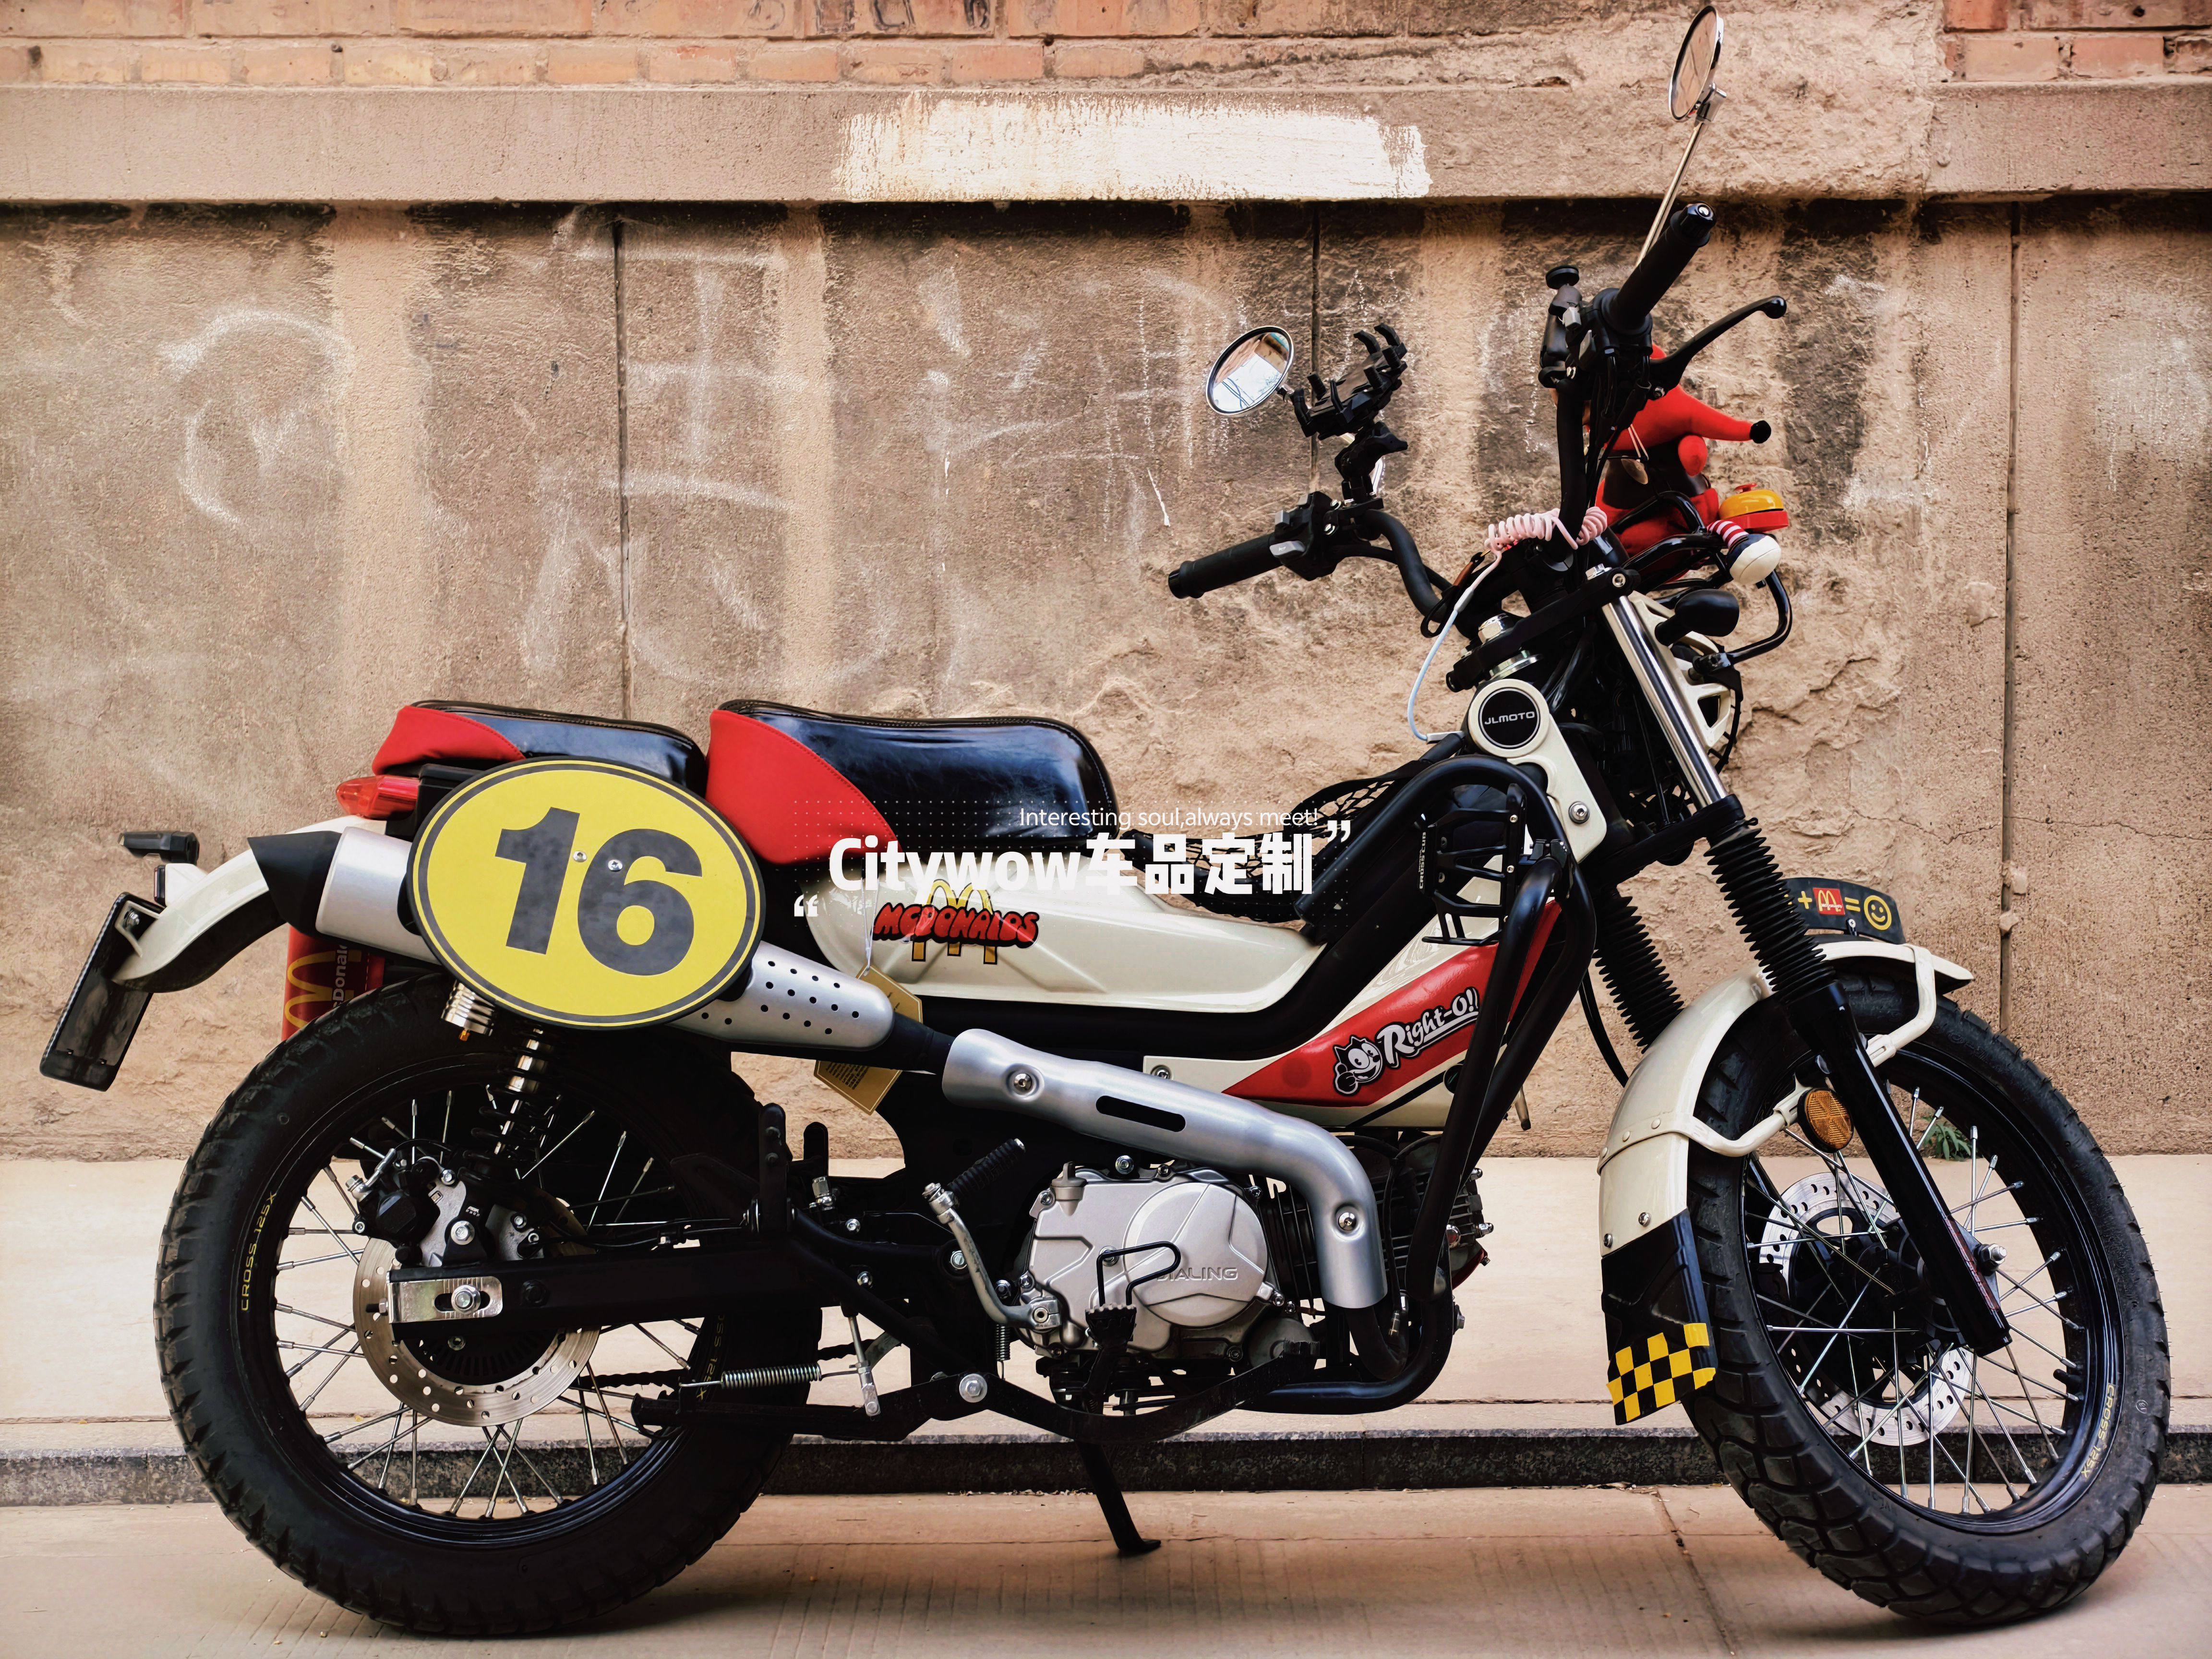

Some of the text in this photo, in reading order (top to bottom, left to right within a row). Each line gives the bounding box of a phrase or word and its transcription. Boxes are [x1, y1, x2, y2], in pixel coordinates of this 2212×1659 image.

[1484, 711, 1535, 725] JLMOTO
[494, 806, 703, 977] 16
[1377, 989, 1476, 1064] Right-O!
[241, 1191, 276, 1311] CROSS 125X
[2081, 1384, 2114, 1478] CROSS 125X
